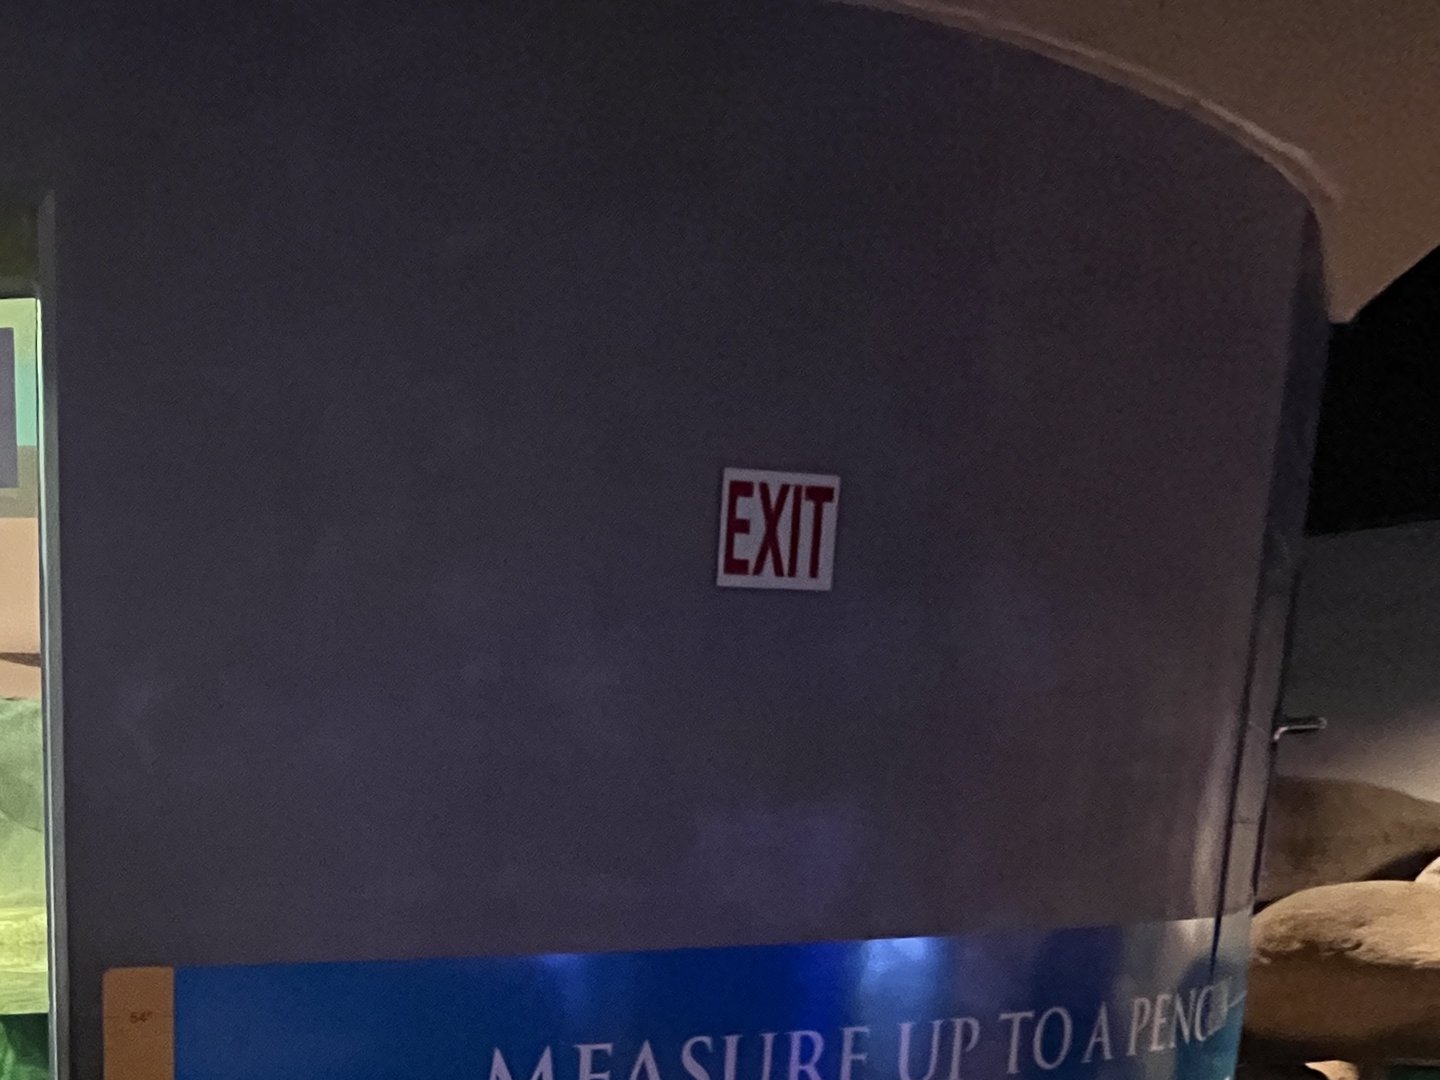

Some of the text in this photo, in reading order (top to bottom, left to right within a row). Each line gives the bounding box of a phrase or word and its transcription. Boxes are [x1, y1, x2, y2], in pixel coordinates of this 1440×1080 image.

[723, 480, 835, 579] EXIT
[998, 1006, 1073, 1075] TO
[1082, 1003, 1114, 1064] A
